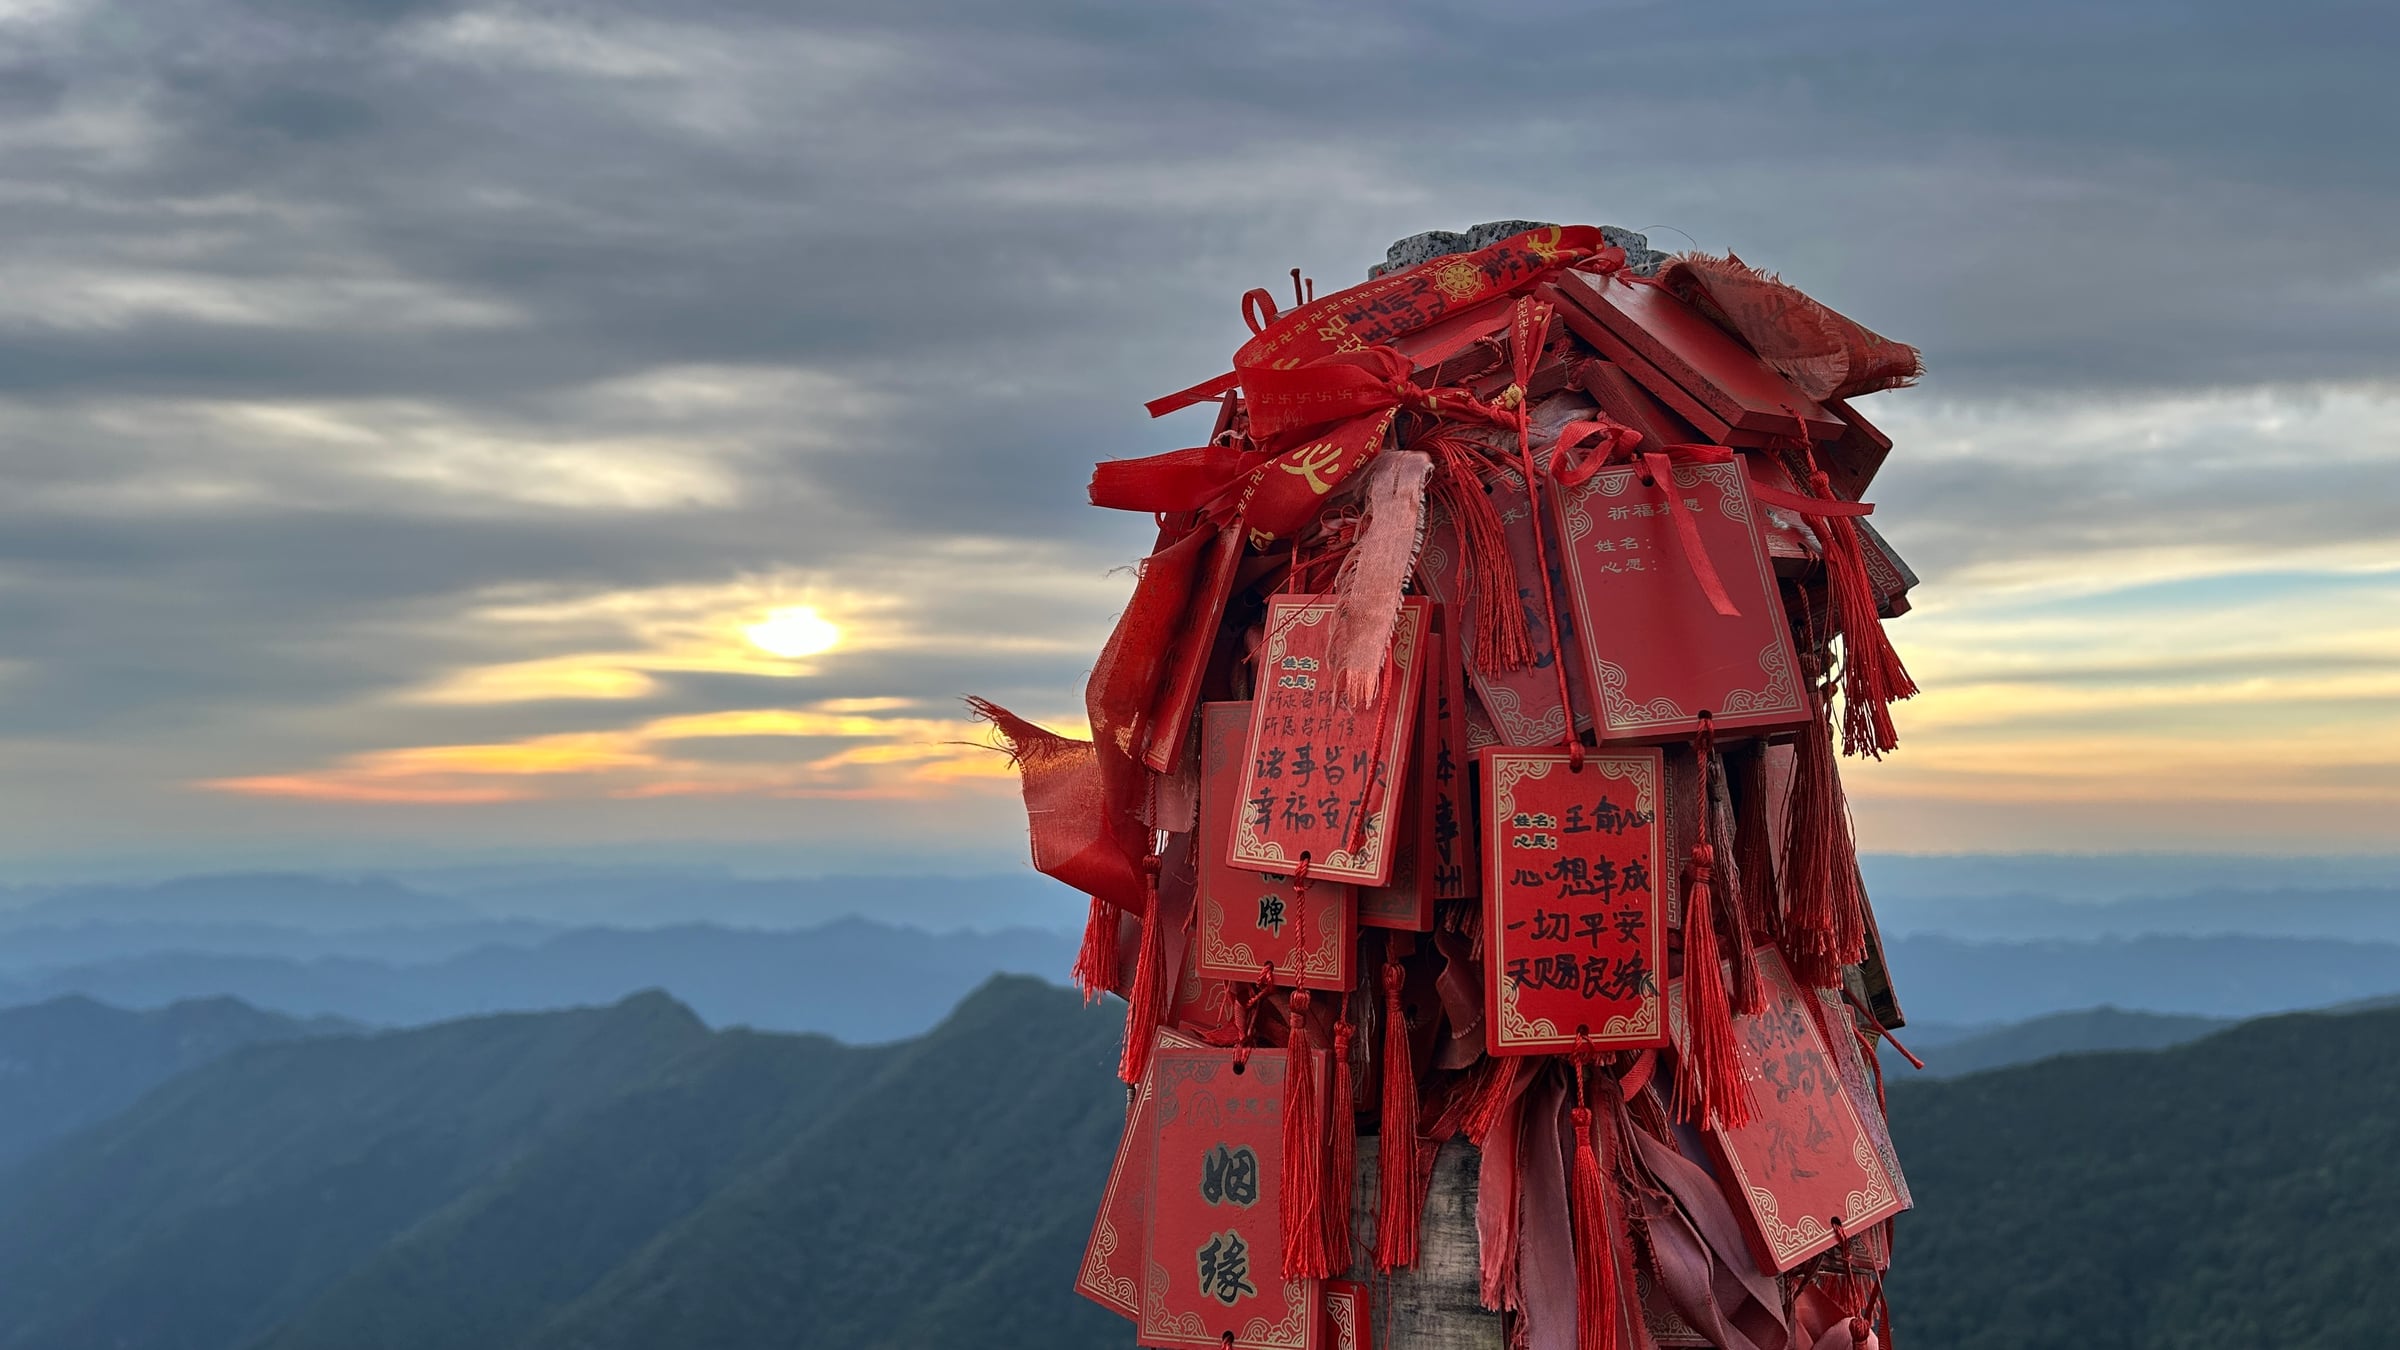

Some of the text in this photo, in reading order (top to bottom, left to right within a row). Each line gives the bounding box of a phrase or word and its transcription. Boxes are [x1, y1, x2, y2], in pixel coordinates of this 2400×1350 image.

[1594, 537, 1652, 553] 姓名：
[1281, 656, 1319, 671] 姓名：
[1513, 813, 1557, 829] 姓名：
[1510, 854, 1652, 904] 心想事成
[1507, 904, 1647, 949] 一切平安
[1507, 950, 1661, 1001] 天赐良缘
[1197, 1141, 1260, 1307] 姻缘
